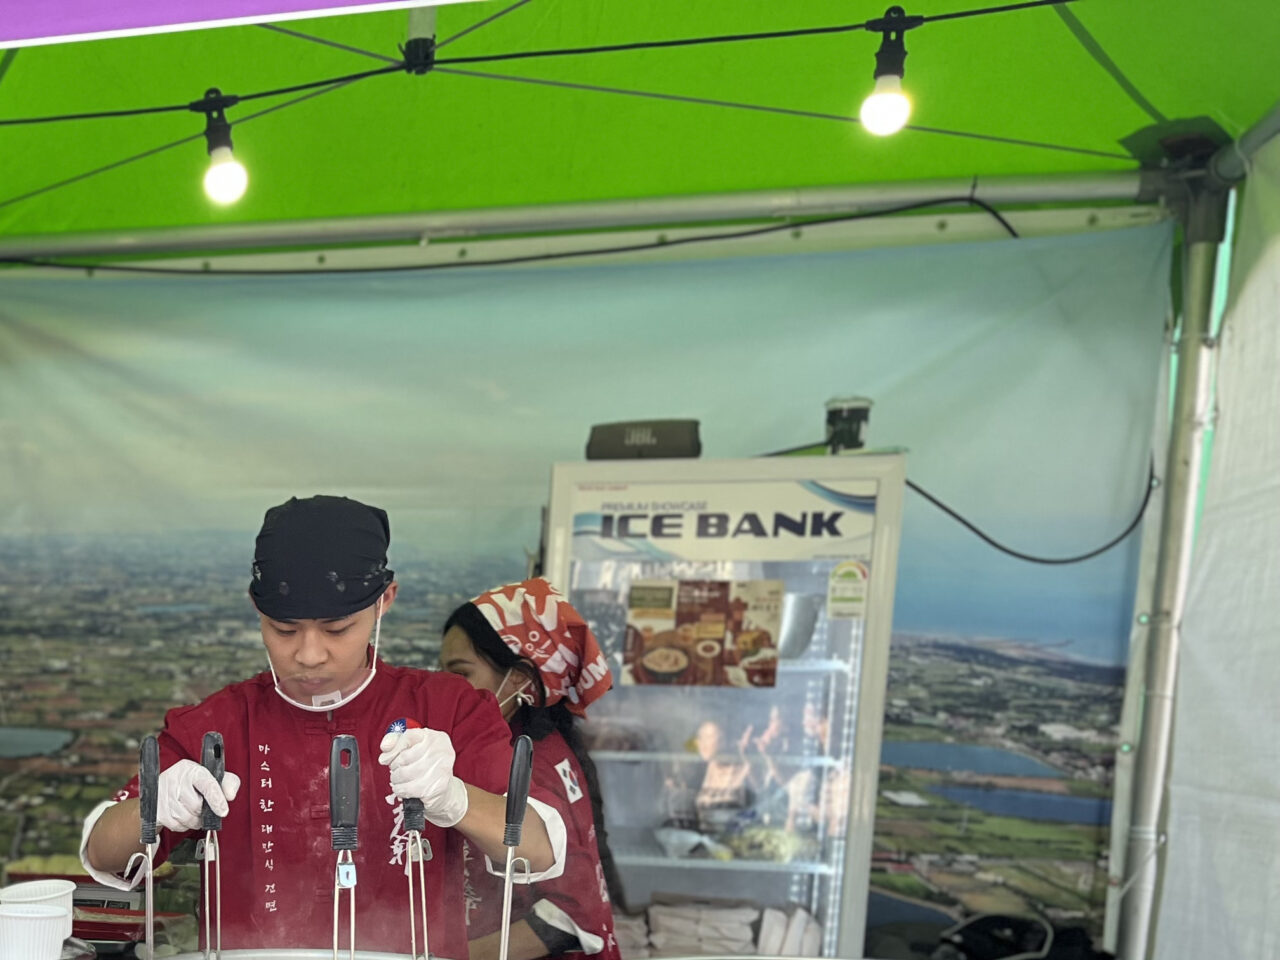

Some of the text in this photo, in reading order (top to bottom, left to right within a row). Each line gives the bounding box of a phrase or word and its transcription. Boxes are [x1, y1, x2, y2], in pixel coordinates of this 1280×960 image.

[600, 511, 845, 539] ICE BANK
[258, 743, 273, 790] 마스터
